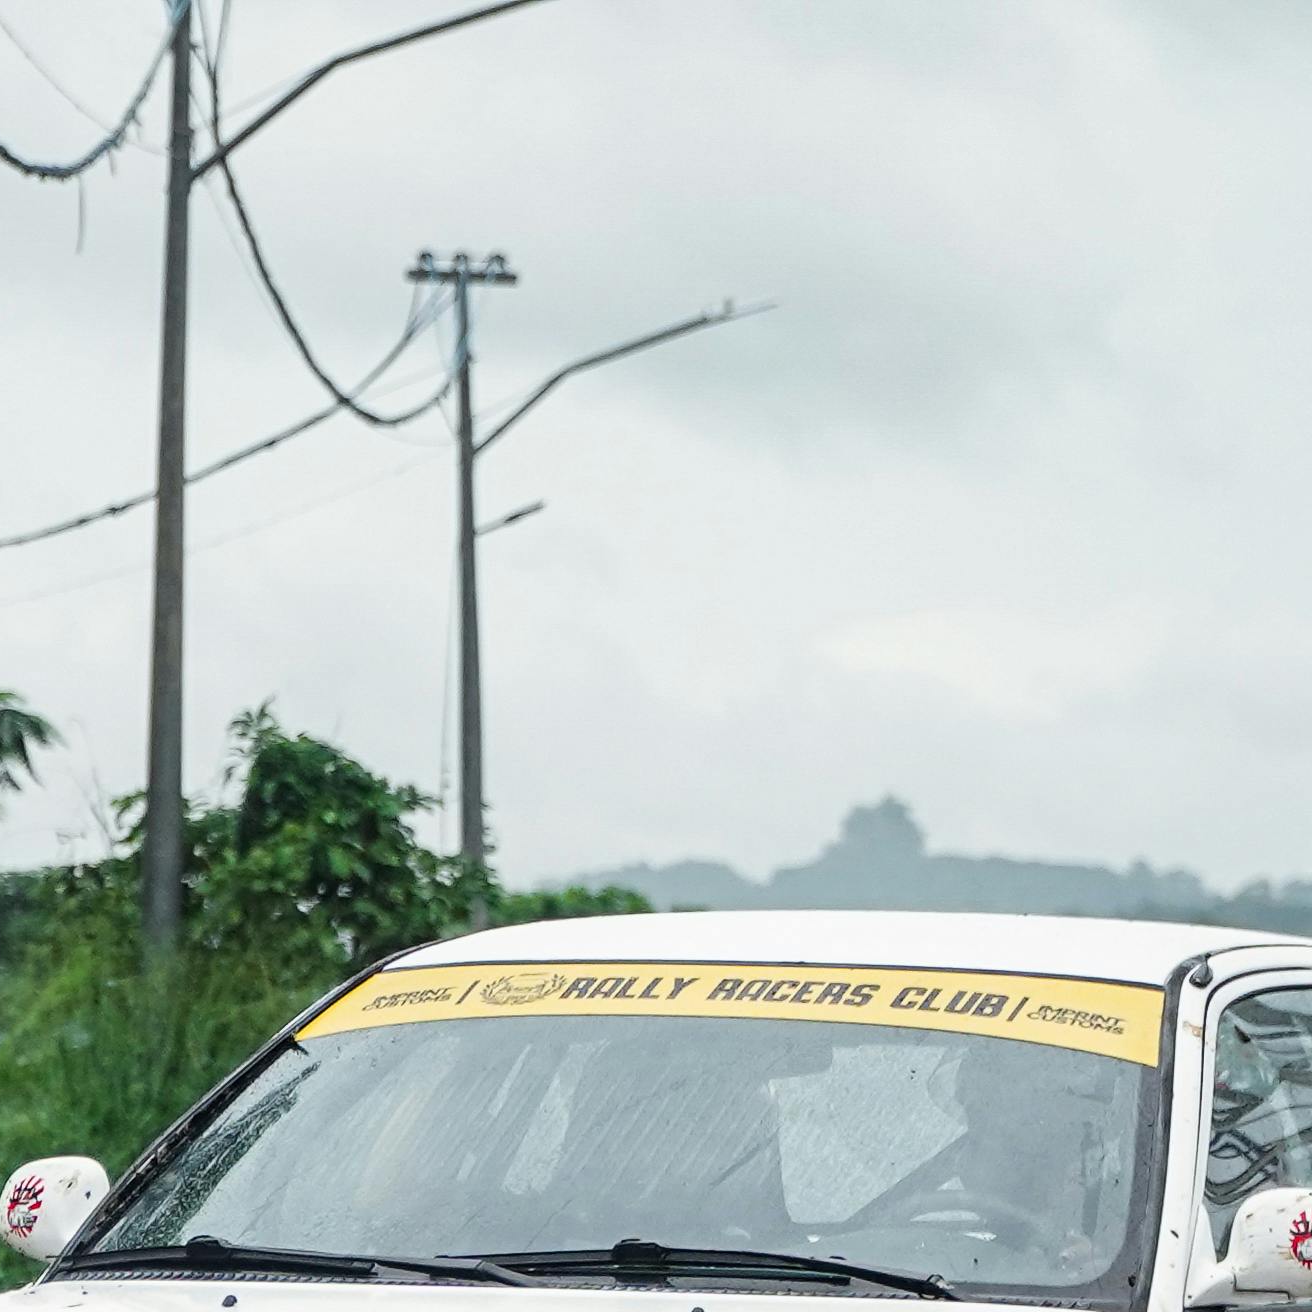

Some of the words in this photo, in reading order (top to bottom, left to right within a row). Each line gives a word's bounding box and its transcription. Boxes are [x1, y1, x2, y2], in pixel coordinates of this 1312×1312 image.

[561, 975, 700, 1000] RALLY
[706, 978, 881, 1008] RACERS
[890, 986, 1010, 1019] CLUB
[1027, 1012, 1124, 1035] CUSTOMS
[1036, 1004, 1127, 1027] IMPRINT
